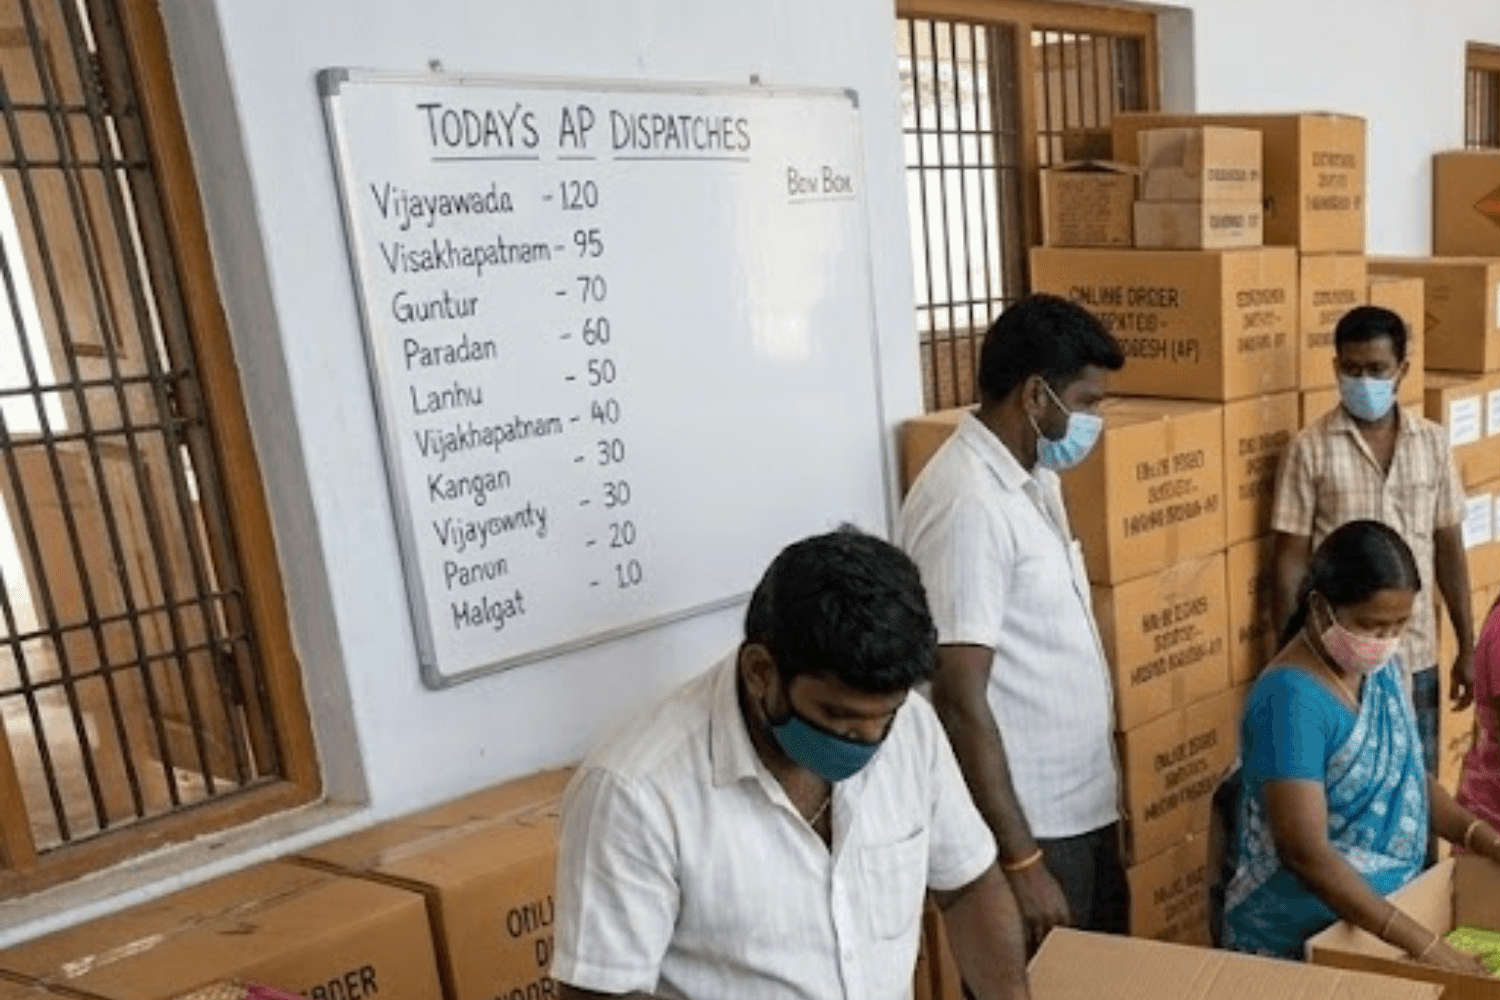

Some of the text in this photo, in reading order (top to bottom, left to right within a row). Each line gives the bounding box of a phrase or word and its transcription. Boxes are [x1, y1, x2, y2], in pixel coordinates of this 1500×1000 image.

[416, 102, 751, 151] TODAY'S AP DISPATCHES
[370, 181, 514, 231] Vijayawada
[380, 234, 551, 277] Visakhapatnam
[573, 229, 604, 257] 95
[392, 288, 478, 323] Guntur
[576, 275, 607, 303] 70
[403, 333, 497, 371] Paradan
[582, 317, 610, 346] 60
[587, 359, 616, 386] 50
[591, 398, 620, 424] 40
[427, 469, 511, 507] Kangan
[597, 438, 625, 466] 30
[603, 480, 631, 508] 30
[609, 520, 636, 548] 20
[615, 559, 642, 588] 10
